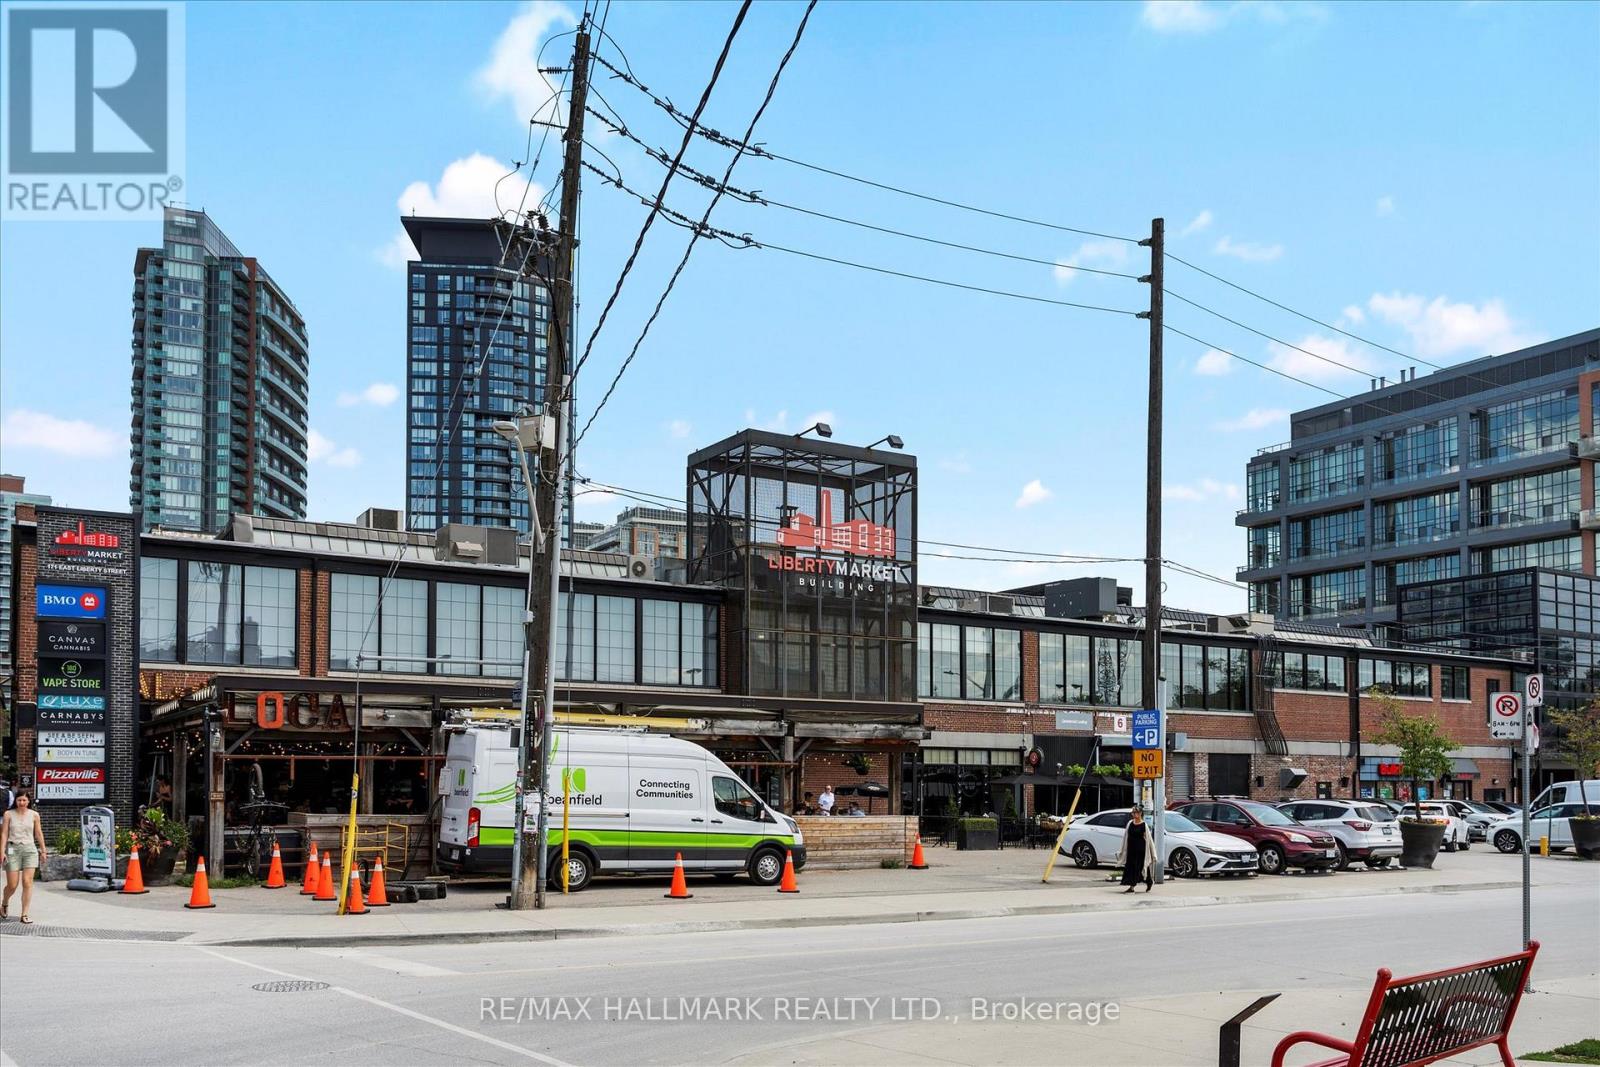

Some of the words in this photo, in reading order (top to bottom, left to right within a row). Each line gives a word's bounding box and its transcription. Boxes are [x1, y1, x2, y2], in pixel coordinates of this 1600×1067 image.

[800, 578, 874, 592] BUILDING
[44, 595, 76, 606] BMO
[48, 636, 96, 644] CANVAS
[43, 678, 68, 688] VAPE
[70, 679, 100, 688] STORE
[1117, 718, 1123, 728] 6
[1141, 754, 1154, 762] NO
[42, 769, 99, 779] Pizzaville
[1137, 766, 1158, 774] EXIT
[640, 779, 690, 790] Connecting
[636, 789, 694, 799] Communities
